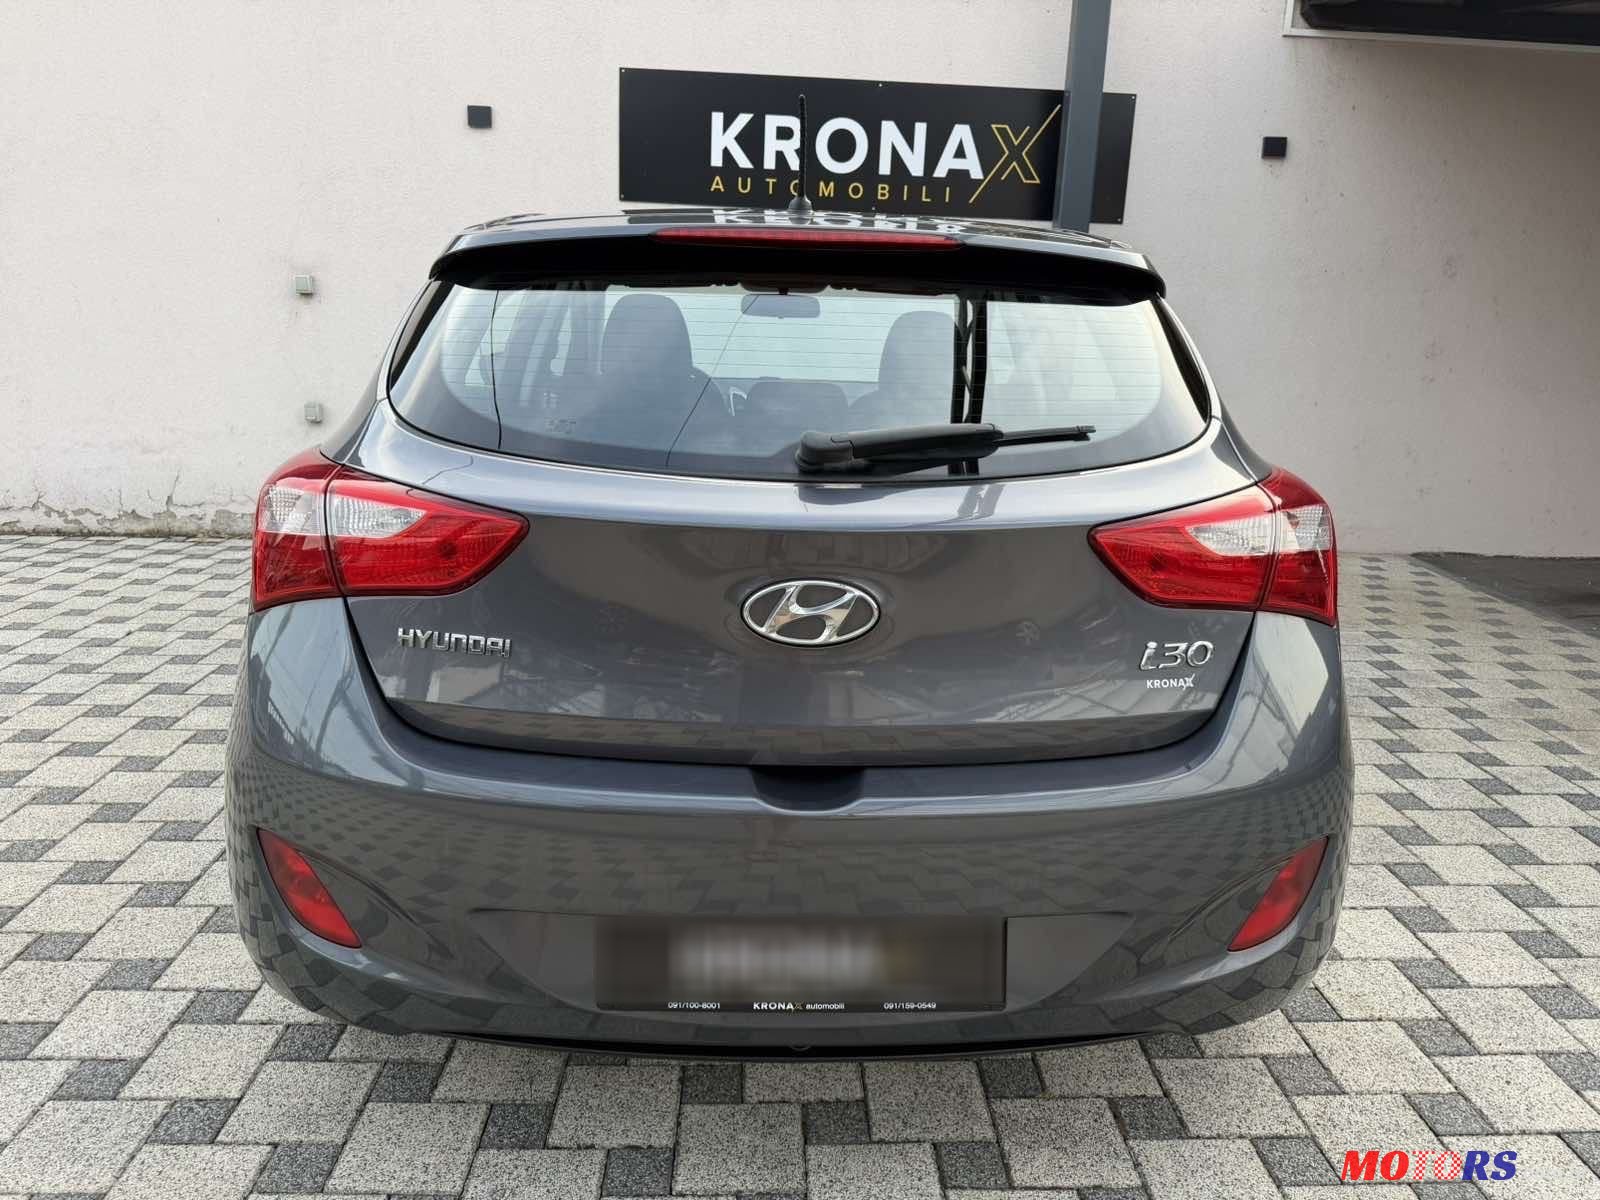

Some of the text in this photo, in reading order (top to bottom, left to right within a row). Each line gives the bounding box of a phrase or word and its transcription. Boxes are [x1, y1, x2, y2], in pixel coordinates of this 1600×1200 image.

[709, 103, 1061, 203] KRONAX
[710, 175, 951, 203] AUTOMOBILI
[398, 627, 511, 658] HYUNDAI
[1139, 640, 1214, 671] i30
[1146, 674, 1196, 690] KRONAX
[805, 1002, 845, 1010] automobili
